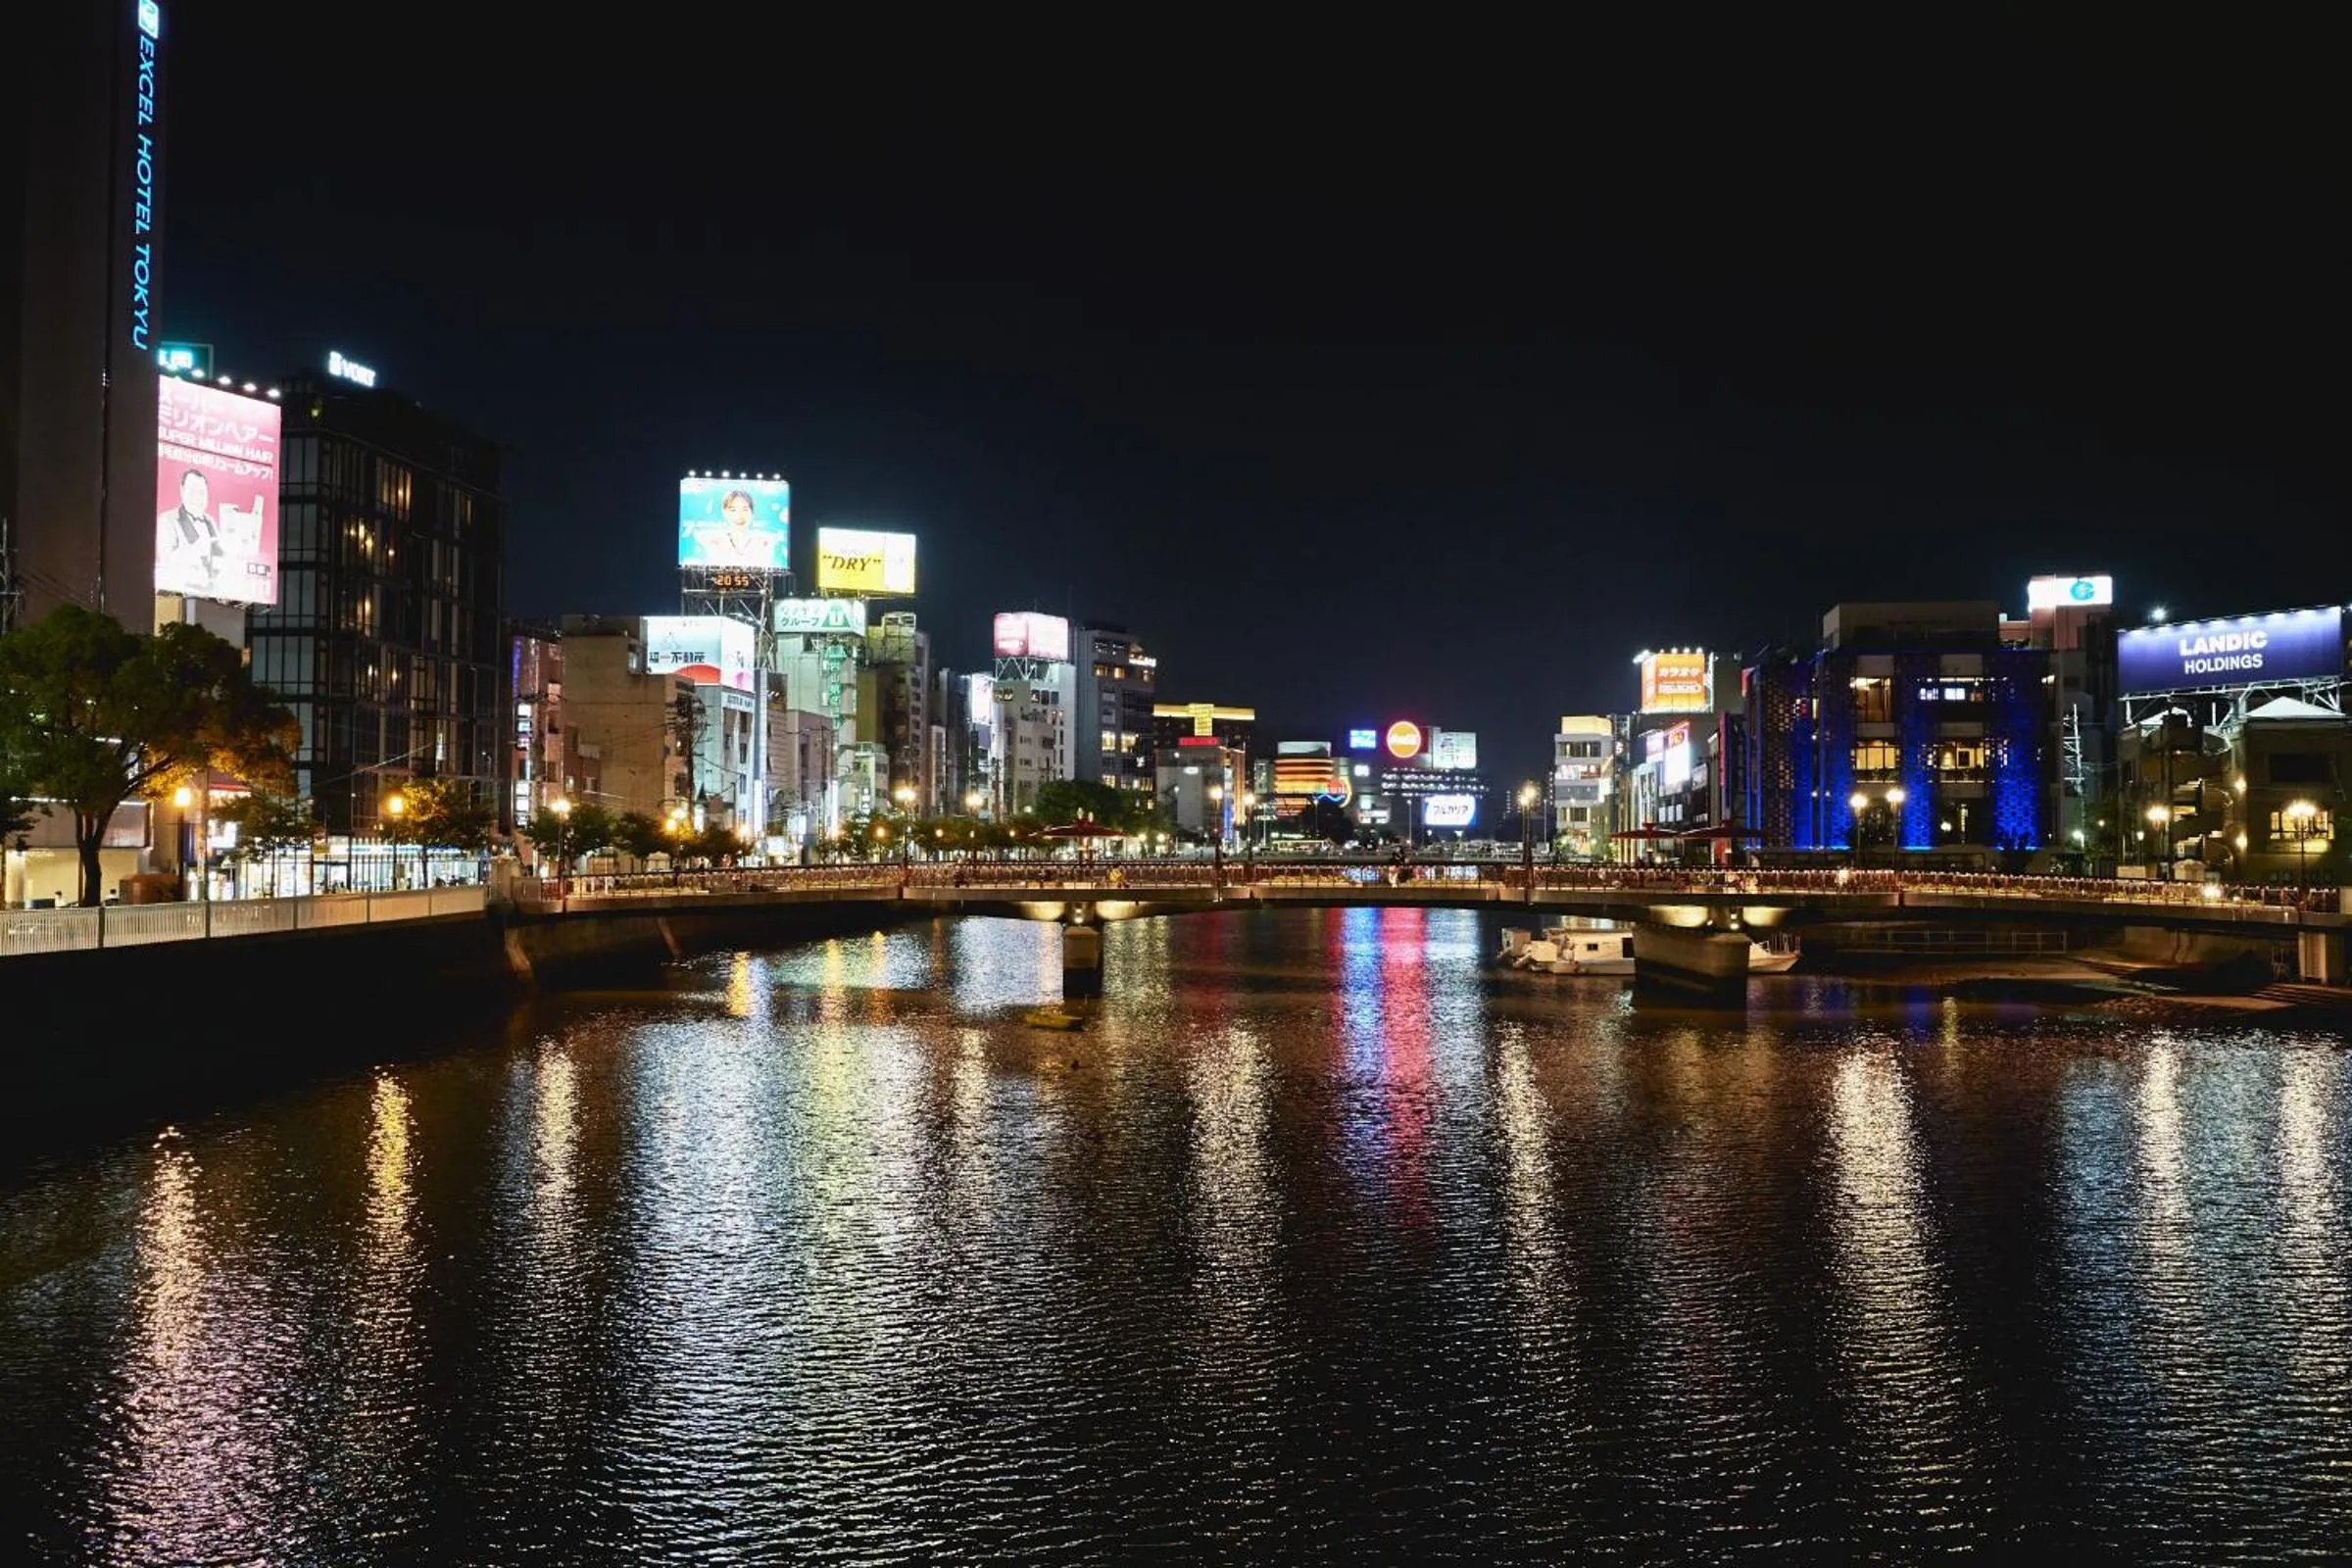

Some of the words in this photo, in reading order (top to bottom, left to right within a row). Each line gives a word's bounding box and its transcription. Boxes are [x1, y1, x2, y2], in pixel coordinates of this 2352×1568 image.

[137, 35, 155, 126] EXCEL
[136, 133, 153, 235] HOTEL
[132, 243, 150, 351] TOKYU
[2179, 630, 2268, 657] LANDIC
[2184, 653, 2264, 675] HOLDINGS
